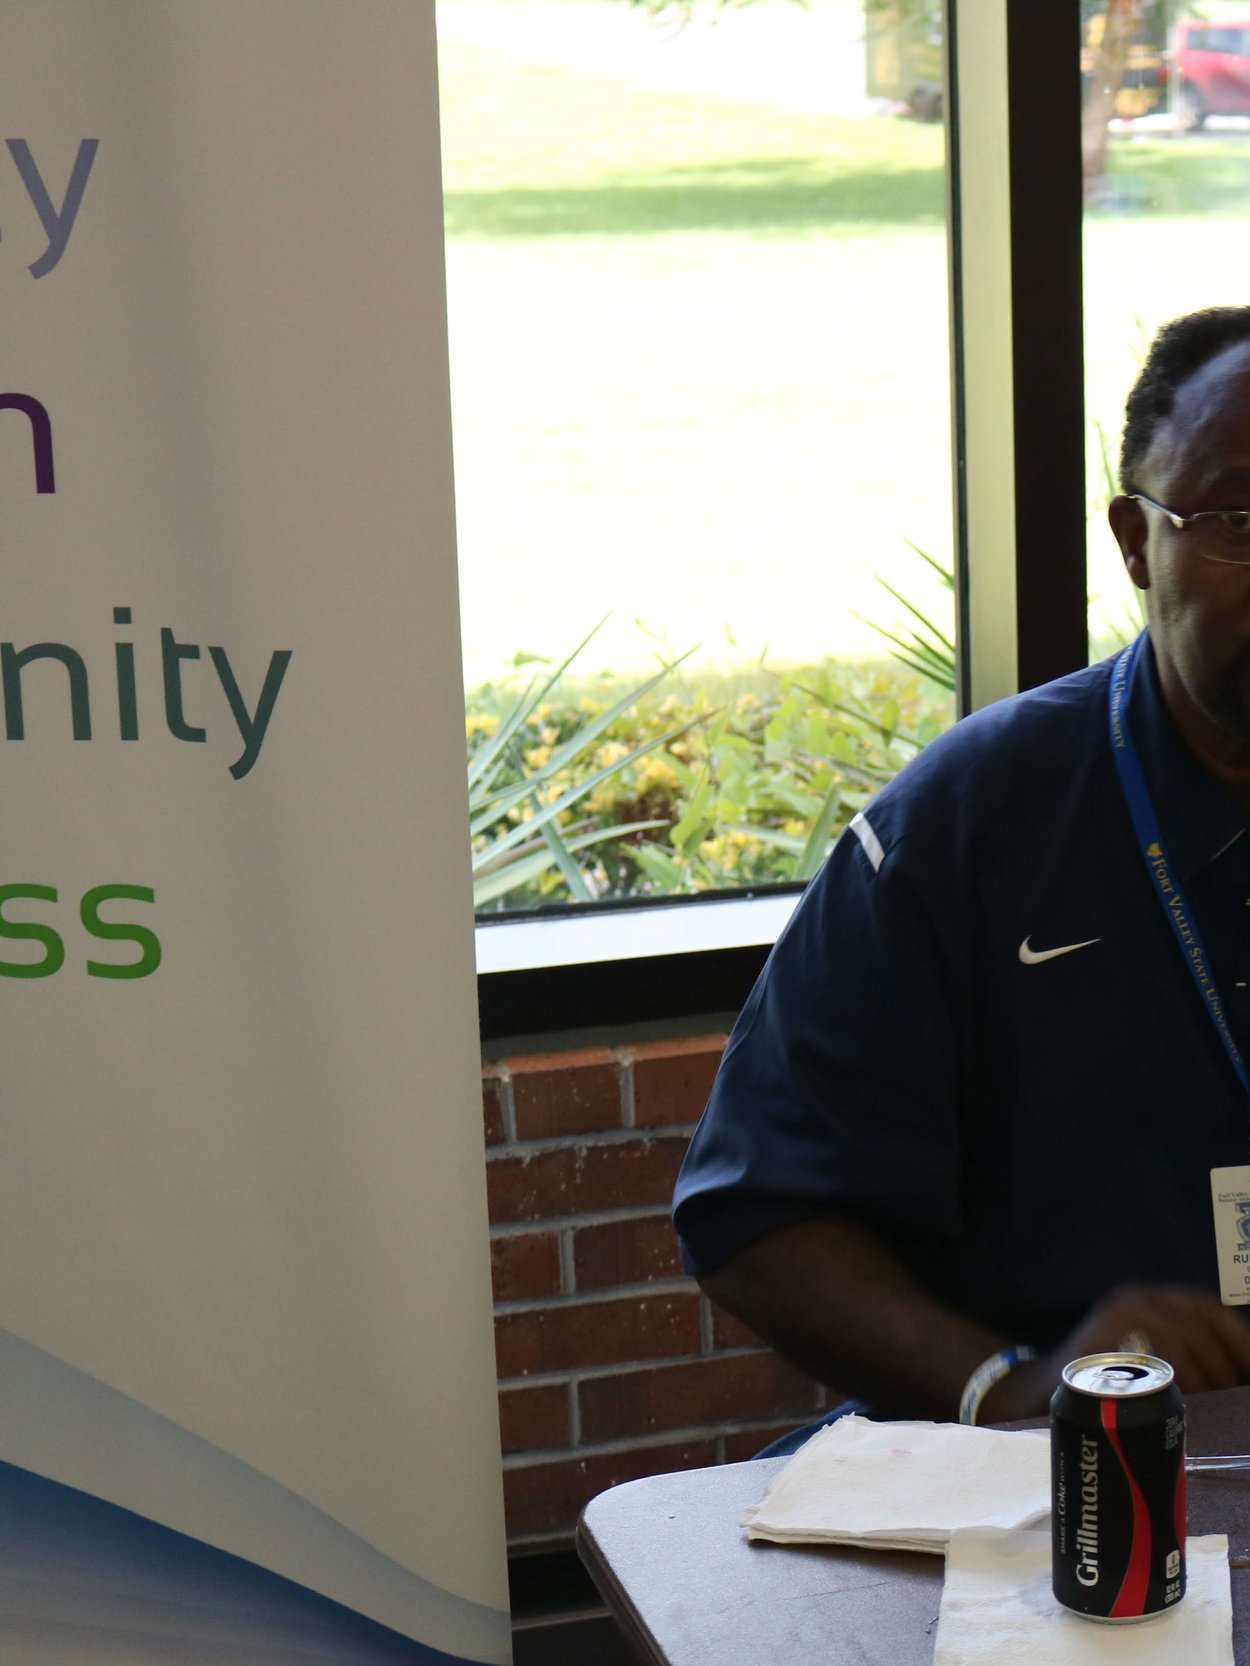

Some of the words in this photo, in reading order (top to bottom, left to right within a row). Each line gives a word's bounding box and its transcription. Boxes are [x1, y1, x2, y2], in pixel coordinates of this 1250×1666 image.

[0, 606, 293, 781] nity
[0, 882, 162, 980] ss
[1151, 858, 1175, 894] FORT
[1168, 895, 1195, 946] VALLEY
[1189, 946, 1210, 984] STATE
[1076, 1433, 1099, 1587] Grillmaster
